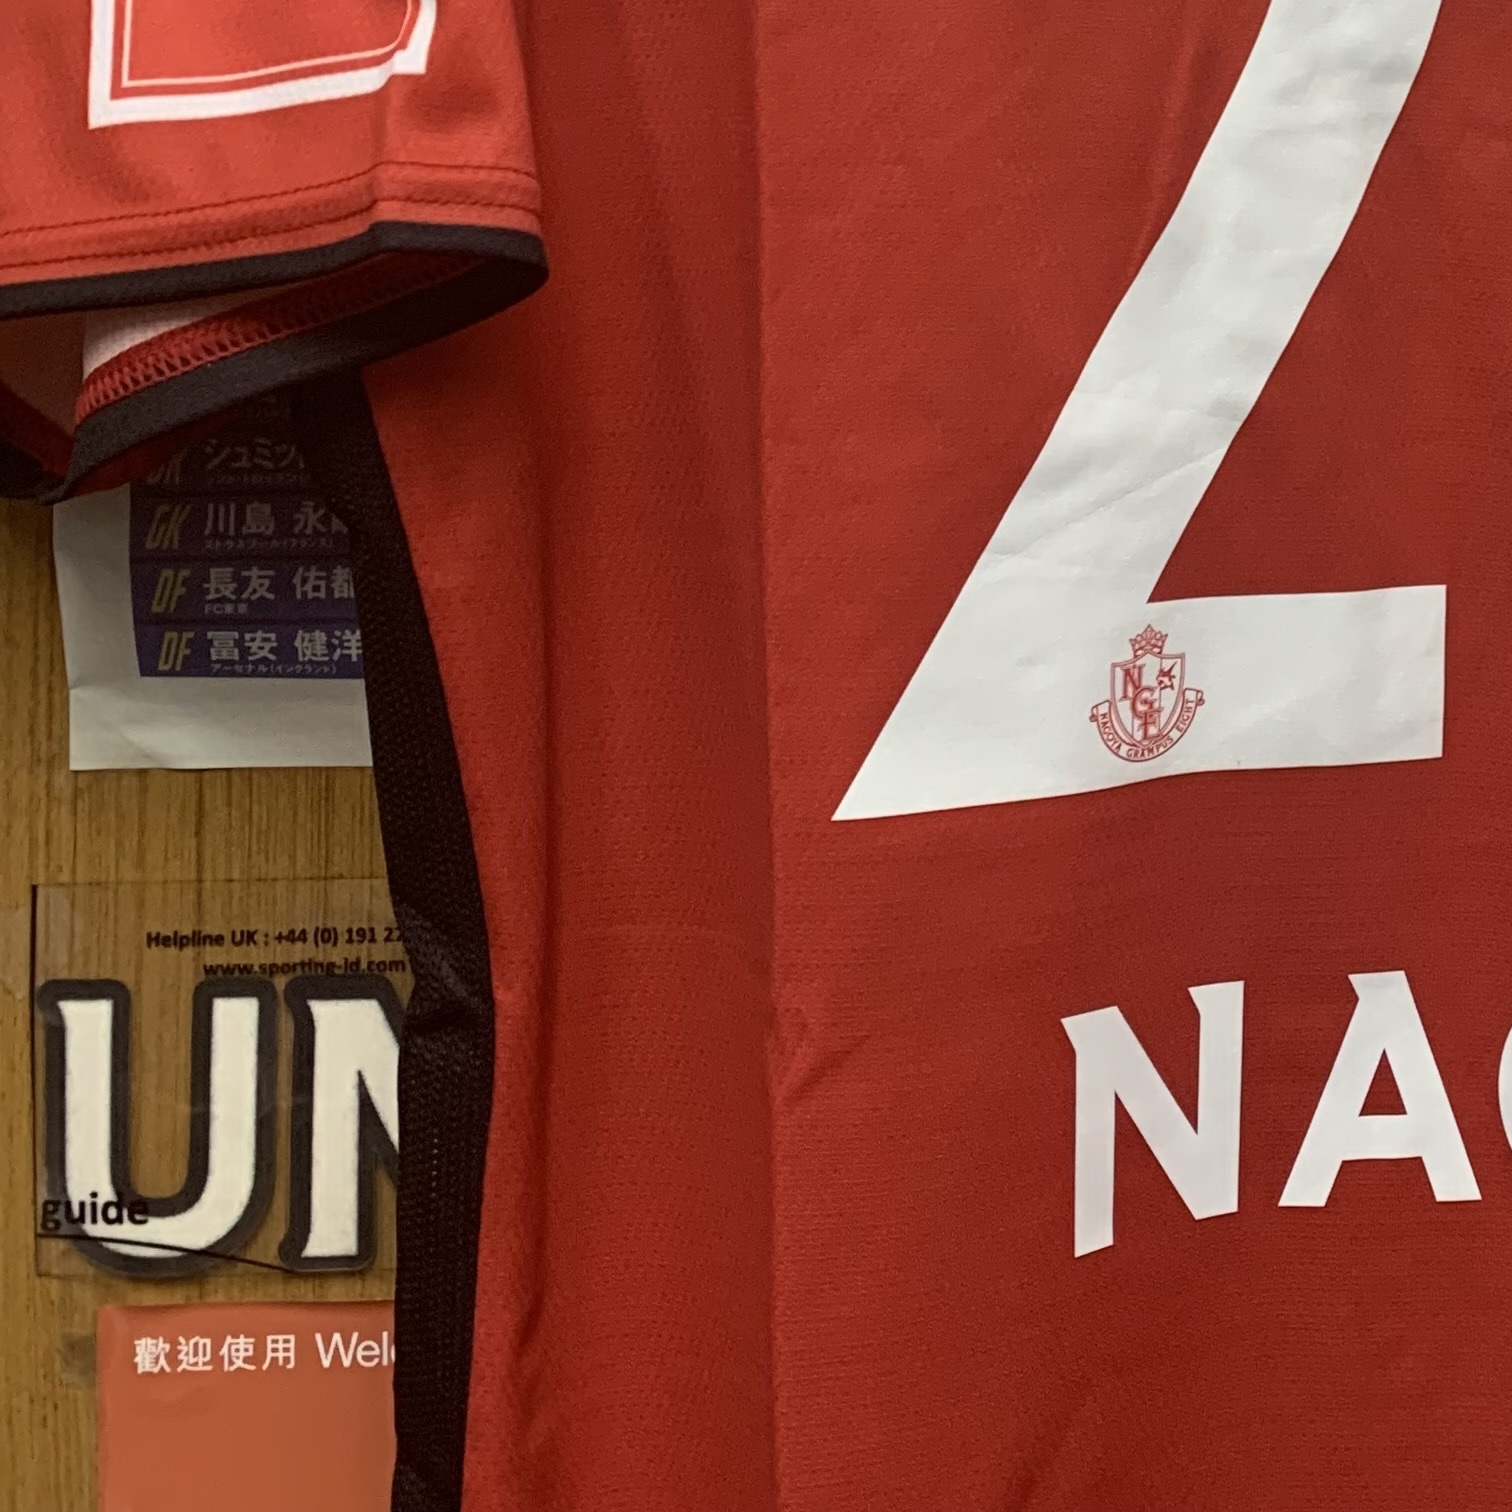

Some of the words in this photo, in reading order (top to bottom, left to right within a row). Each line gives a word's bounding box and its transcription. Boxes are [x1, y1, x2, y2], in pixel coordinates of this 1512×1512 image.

[145, 504, 193, 550] GK
[204, 502, 275, 536] 川島
[292, 501, 348, 535] 永
[203, 568, 275, 601] 長友
[157, 631, 194, 671] DF
[146, 929, 225, 951] Helpline
[231, 929, 258, 946] UK
[275, 929, 307, 945] +44
[313, 926, 338, 948] (0)
[345, 927, 377, 944] 191
[40, 1191, 149, 1232] guide
[133, 1334, 296, 1374] 歡迎使用
[315, 1331, 395, 1369] Wel
